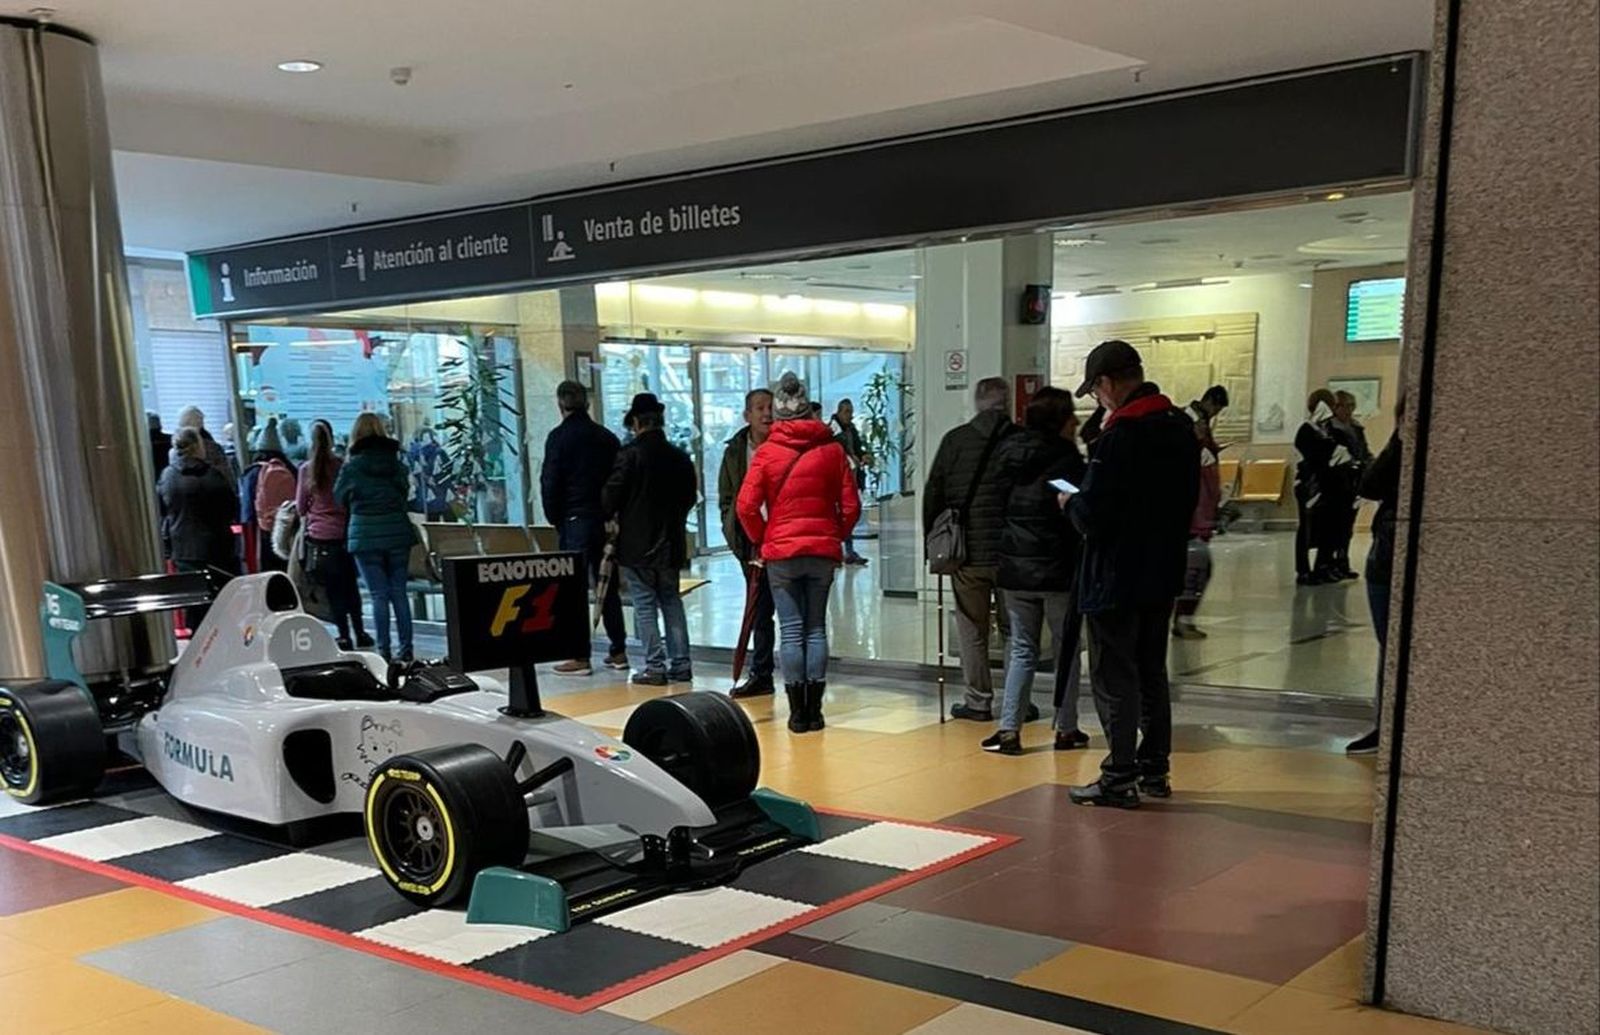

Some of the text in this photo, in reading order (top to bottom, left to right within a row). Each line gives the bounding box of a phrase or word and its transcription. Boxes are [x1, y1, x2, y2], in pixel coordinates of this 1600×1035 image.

[583, 204, 741, 242] Venta de billetes
[373, 234, 509, 270] Atención al cliente
[243, 259, 318, 287] Información
[477, 557, 574, 583] ECNOTRON
[489, 583, 559, 637] F1
[290, 628, 312, 652] 16
[164, 731, 234, 782] FORMULA
